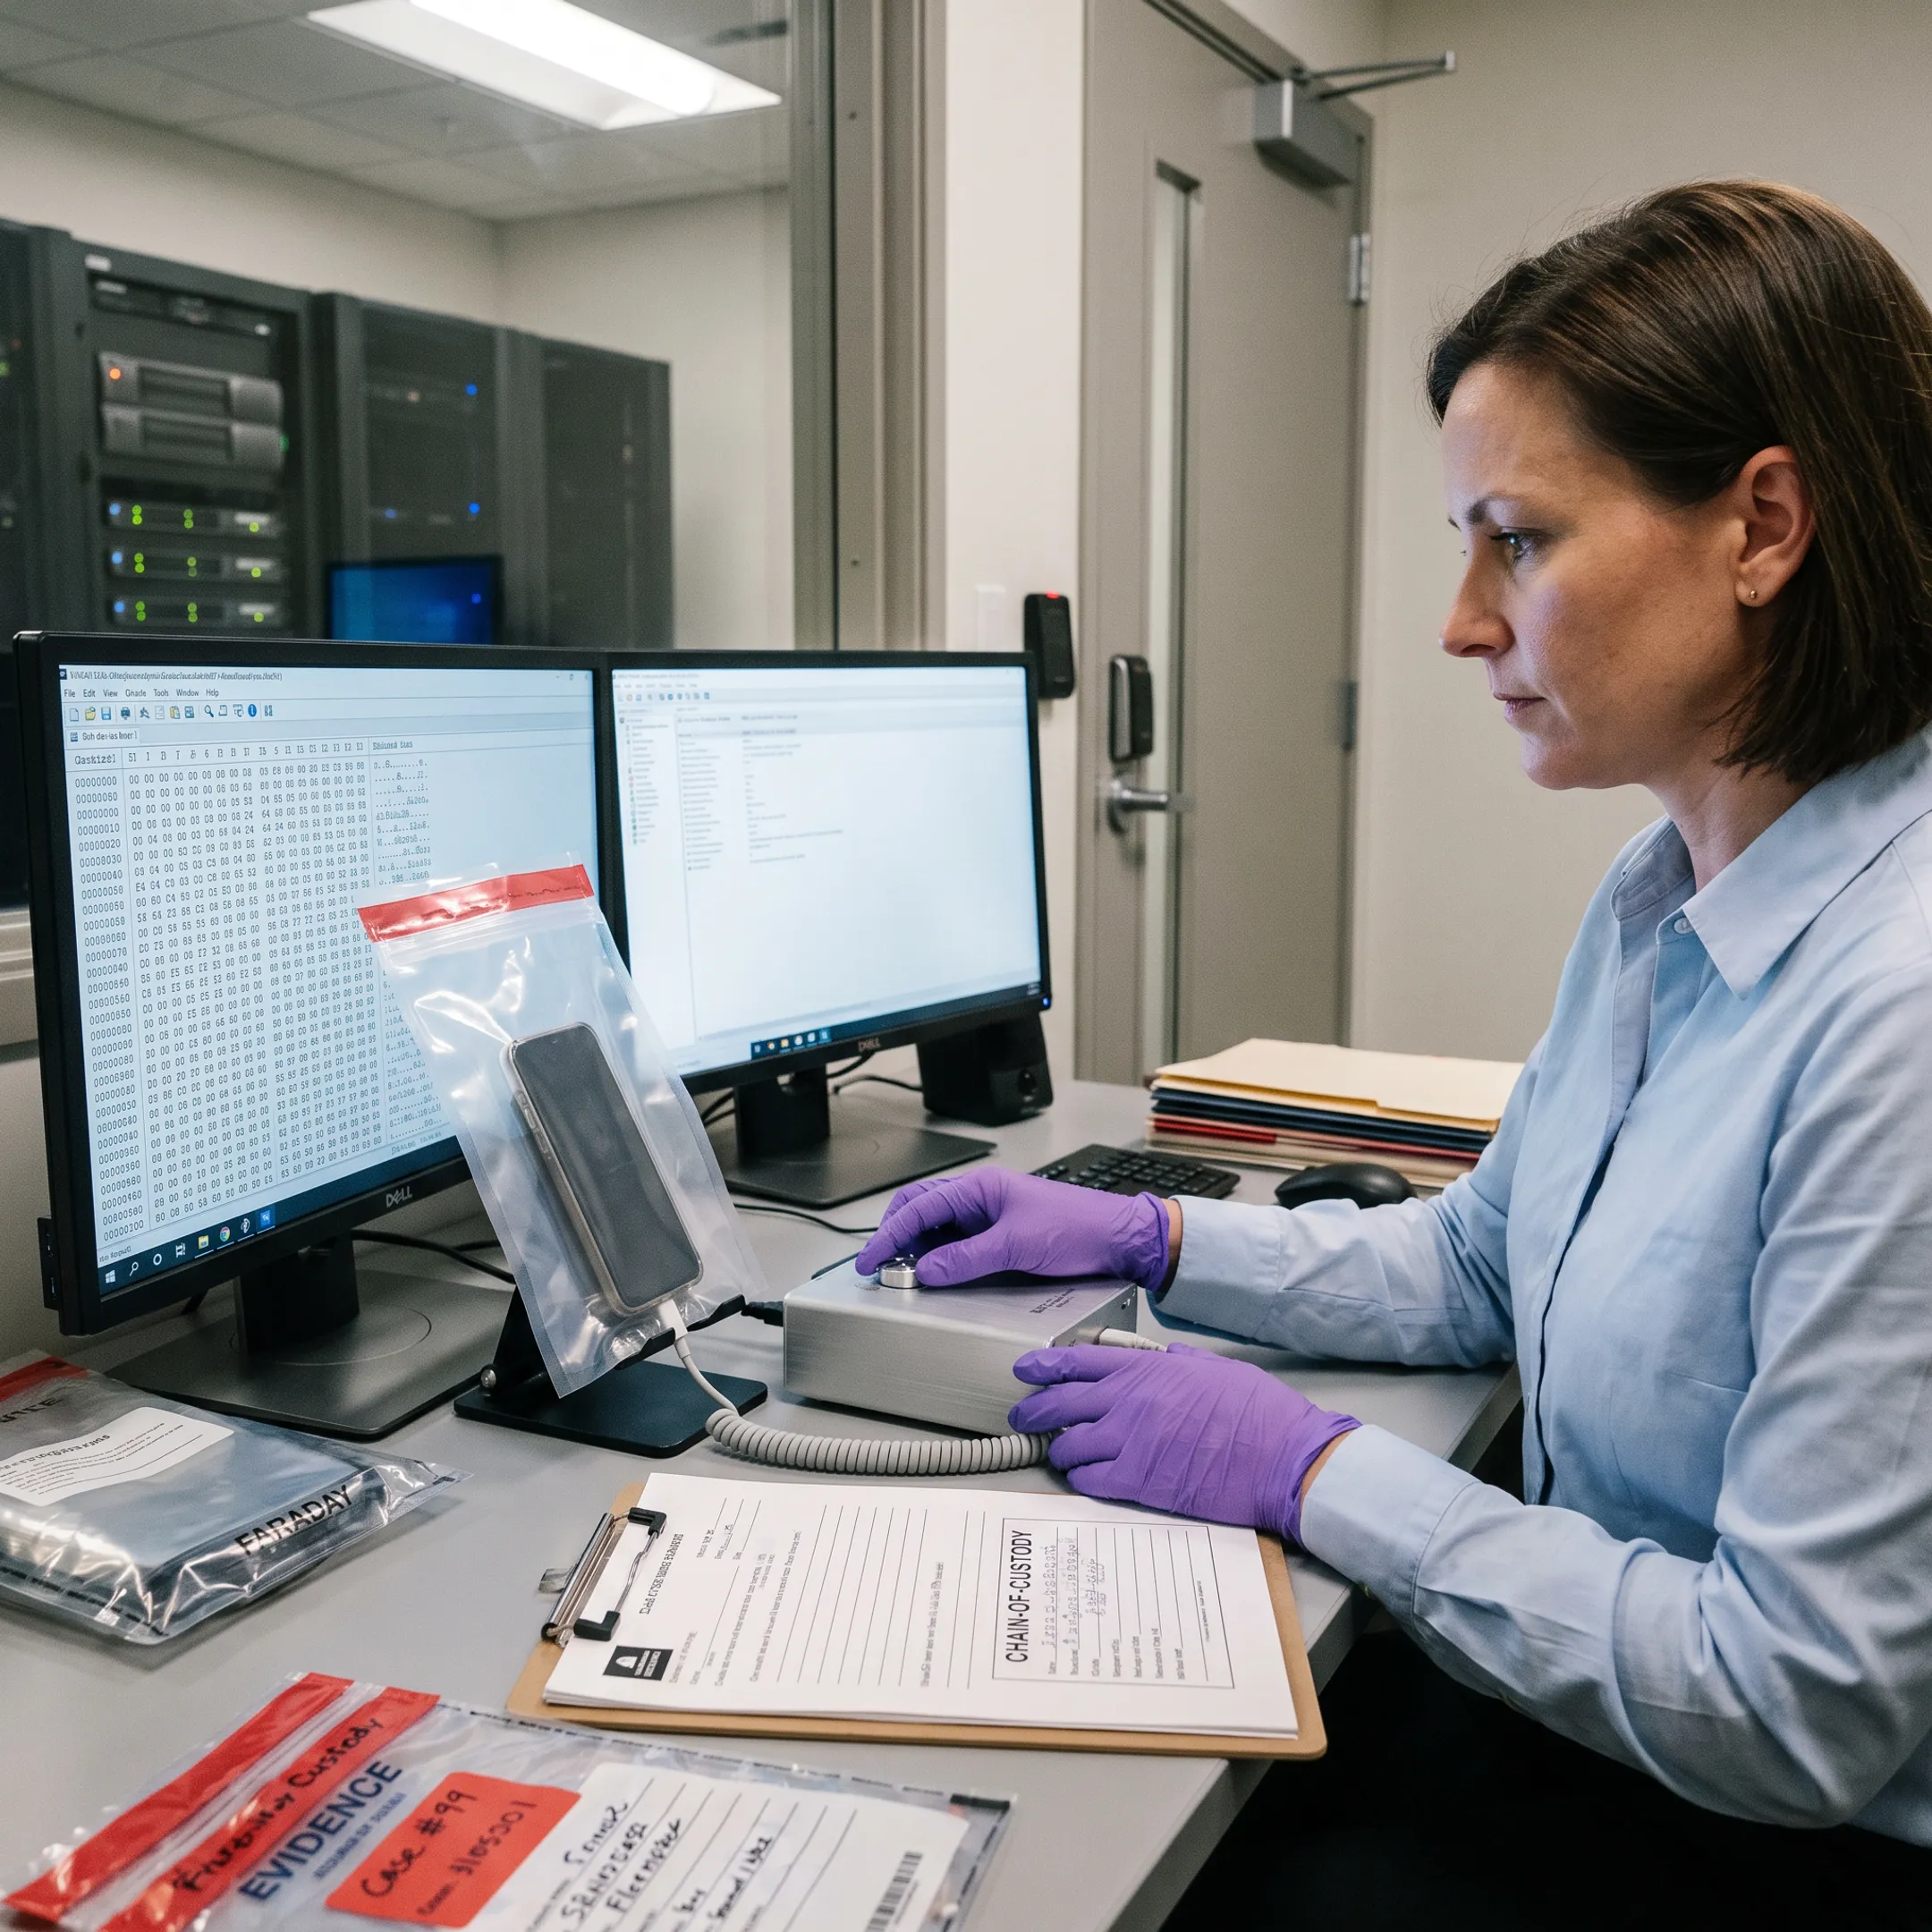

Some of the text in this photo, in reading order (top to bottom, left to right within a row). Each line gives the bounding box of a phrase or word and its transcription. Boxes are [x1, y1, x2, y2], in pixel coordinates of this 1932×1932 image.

[386, 1186, 413, 1208] DELL
[234, 1484, 354, 1556] FARADAY
[1005, 1530, 1032, 1662] CHAIN-OF-CUSTODY
[288, 1717, 381, 1788] Custody
[240, 1760, 402, 1903] EVIDENCE
[360, 1845, 426, 1898] Case
